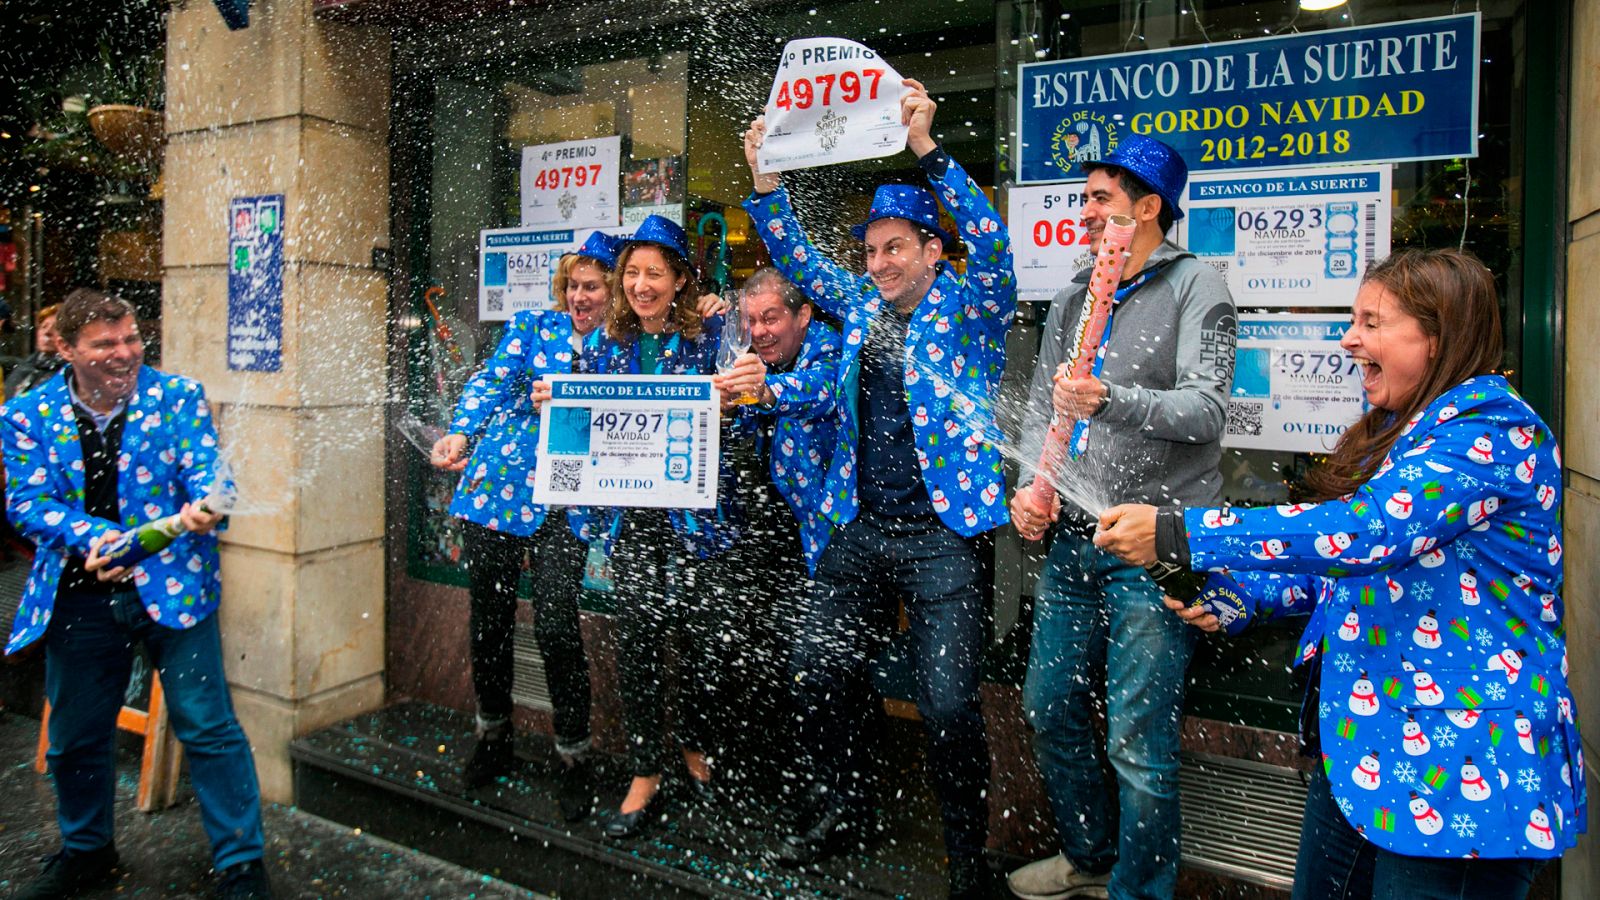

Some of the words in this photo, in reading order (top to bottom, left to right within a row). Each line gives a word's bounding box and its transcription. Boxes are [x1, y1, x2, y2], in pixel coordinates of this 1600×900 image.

[802, 45, 875, 66] PREMIO
[1032, 61, 1180, 108] ESTANCO
[1189, 55, 1235, 95] DE
[1246, 49, 1295, 89] LA
[1303, 30, 1458, 84] SUERTE
[775, 68, 886, 112] 49797
[1130, 104, 1250, 135] GORDO
[1259, 89, 1426, 127] NAVIDAD
[1050, 118, 1072, 173] ESTANCO
[1072, 110, 1089, 122] DE
[1091, 111, 1105, 125] LA
[1200, 129, 1350, 163] 2012-2018
[555, 146, 597, 161] PREMIO
[534, 164, 602, 190] 49797
[1199, 182, 1262, 196] ESTANCO
[1266, 182, 1285, 193] DE
[1289, 181, 1307, 192] LA
[1310, 177, 1369, 191] SUERTE
[1237, 208, 1322, 231] 06293
[1254, 229, 1306, 240] NAVIDAD
[508, 253, 548, 269] 66212
[1257, 249, 1292, 257] diciembre
[1333, 259, 1345, 267] 20
[1247, 278, 1312, 290] OVIEDO
[512, 300, 543, 308] OVIEDO
[1303, 325, 1323, 337] DE
[1326, 325, 1345, 337] LA
[1199, 329, 1215, 364] THE
[1214, 332, 1228, 393] NORTH
[1227, 334, 1237, 381] FACE
[1272, 353, 1357, 375] 49797
[1290, 374, 1343, 385] NAVIDAD
[618, 385, 634, 396] DE
[636, 386, 651, 396] LA
[654, 386, 702, 396] SUERTE
[1293, 394, 1329, 403] diciembre
[592, 412, 664, 433] 49797
[1282, 422, 1348, 436] OVIEDO
[606, 432, 651, 441] NAVIDAD
[599, 478, 654, 490] OVIEDO
[1218, 587, 1247, 619] SUERTE
